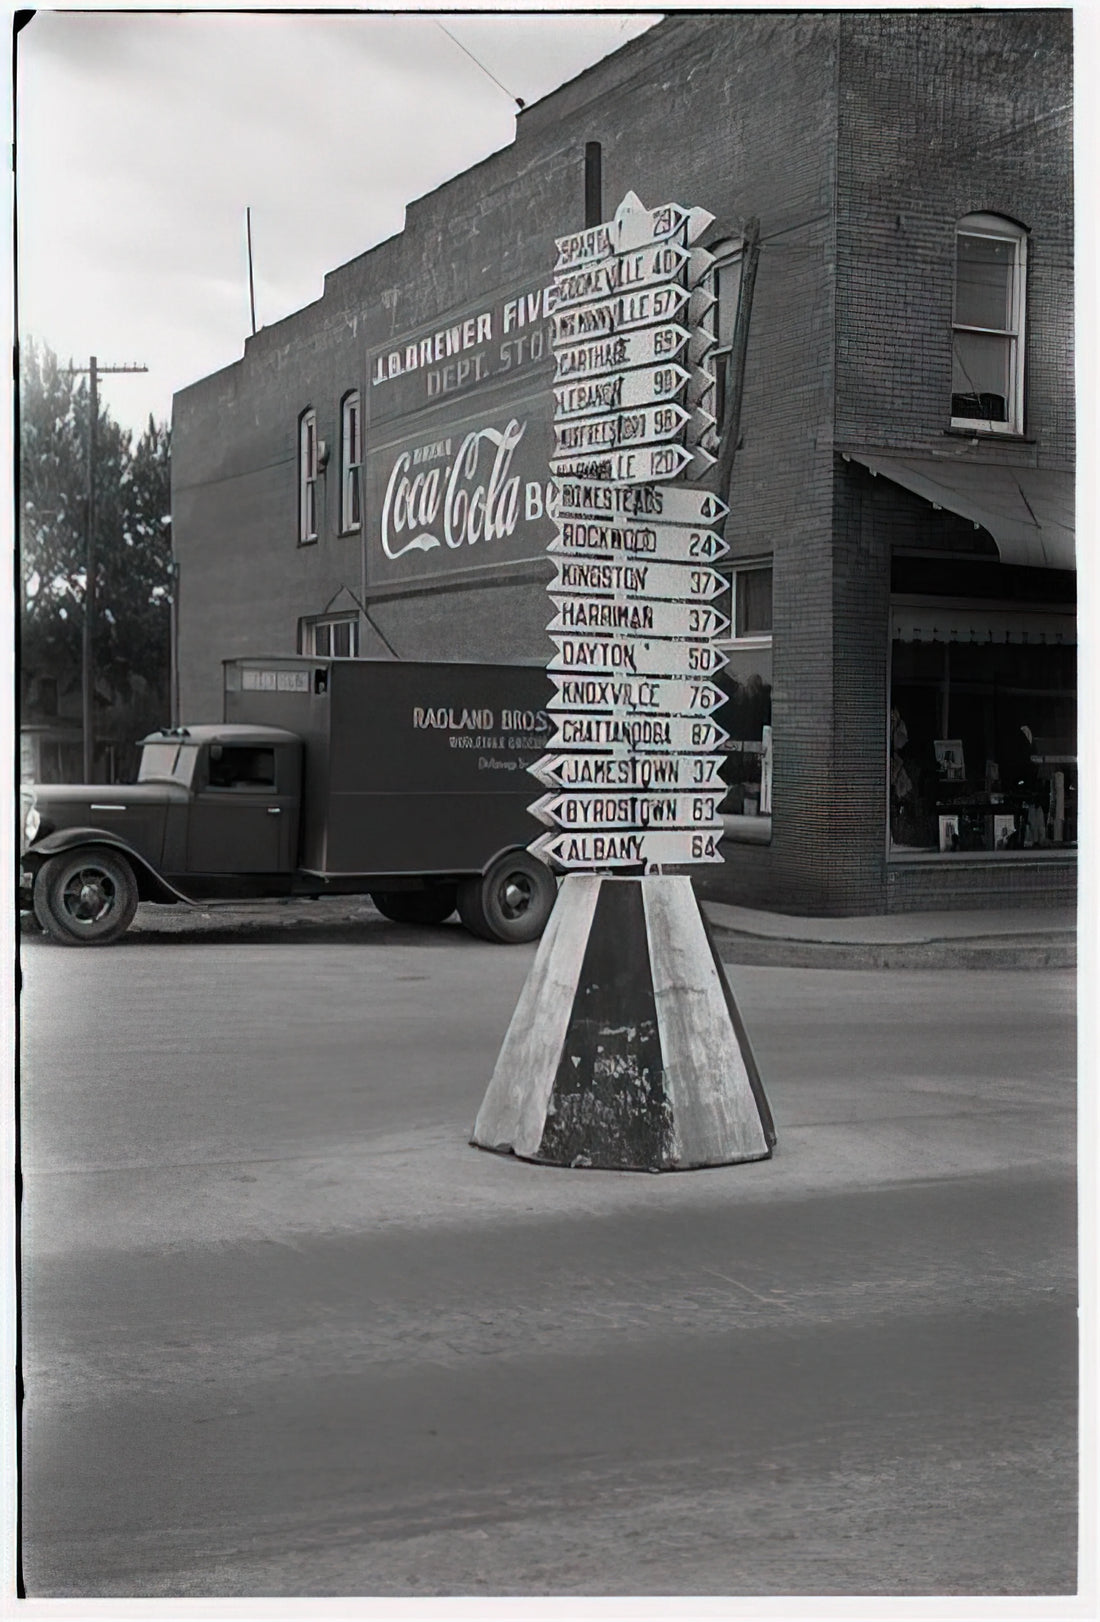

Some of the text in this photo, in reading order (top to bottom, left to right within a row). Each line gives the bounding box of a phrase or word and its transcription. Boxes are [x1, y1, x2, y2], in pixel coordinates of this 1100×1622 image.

[503, 285, 559, 334] FIVE
[651, 448, 674, 476] 120
[700, 497, 712, 518] 4
[562, 523, 712, 557] ROCKWOOD 24
[561, 563, 711, 595] KINGSTON 37
[562, 602, 712, 632] HARRIMAN 37
[562, 640, 711, 671] DAYTON 50
[562, 681, 712, 709] KNOXVILLE 76
[562, 720, 712, 747] CHATTANOOGA 87
[567, 757, 716, 788] JAMESTOWN 37
[566, 797, 715, 827] BYRDSTOWN 63
[566, 835, 715, 862] ALBANY 64
